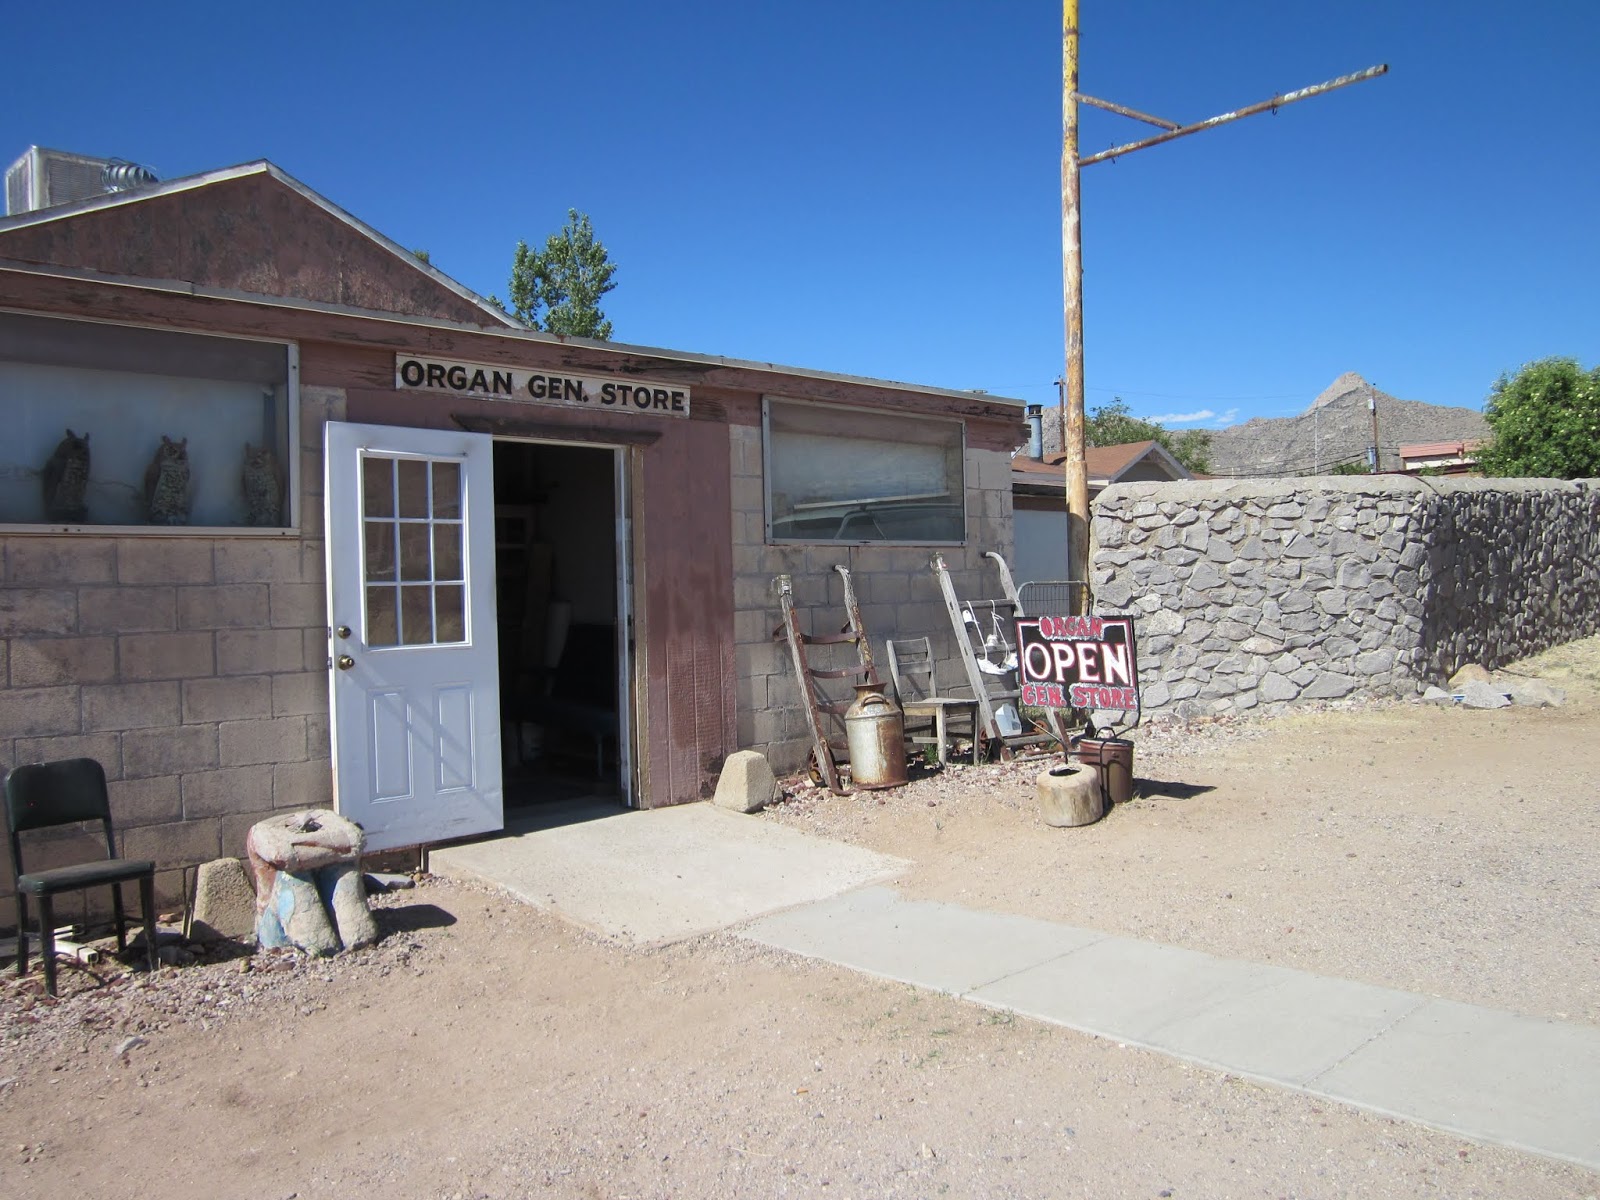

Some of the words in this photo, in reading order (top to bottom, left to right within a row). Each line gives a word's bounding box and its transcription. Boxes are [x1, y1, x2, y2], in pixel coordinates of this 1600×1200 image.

[401, 360, 513, 394] ORGAN
[528, 375, 589, 402] GEN.
[601, 383, 684, 411] STORE
[1040, 617, 1102, 637] ORGAN
[1025, 642, 1129, 684] OPEN
[1022, 685, 1066, 707] GEN.
[1073, 687, 1136, 709] STORE
